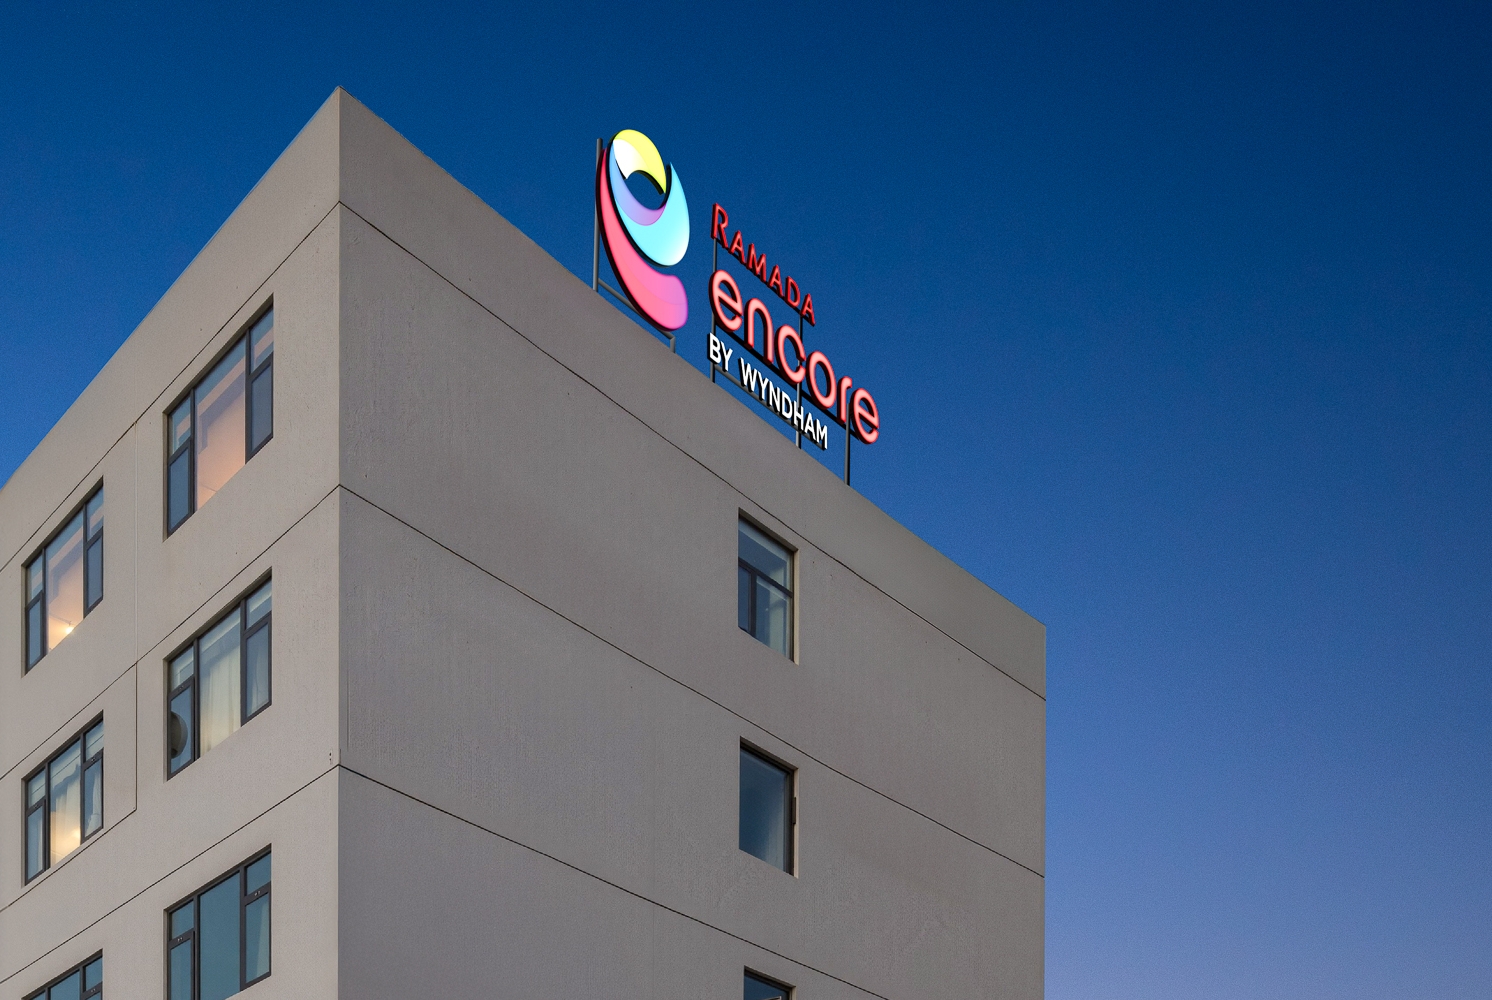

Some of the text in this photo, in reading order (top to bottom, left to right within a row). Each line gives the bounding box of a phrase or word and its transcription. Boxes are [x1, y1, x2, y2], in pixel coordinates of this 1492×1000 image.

[712, 203, 816, 326] RAMADA
[709, 270, 879, 444] encore
[709, 332, 828, 450] BY WYNDHAM
